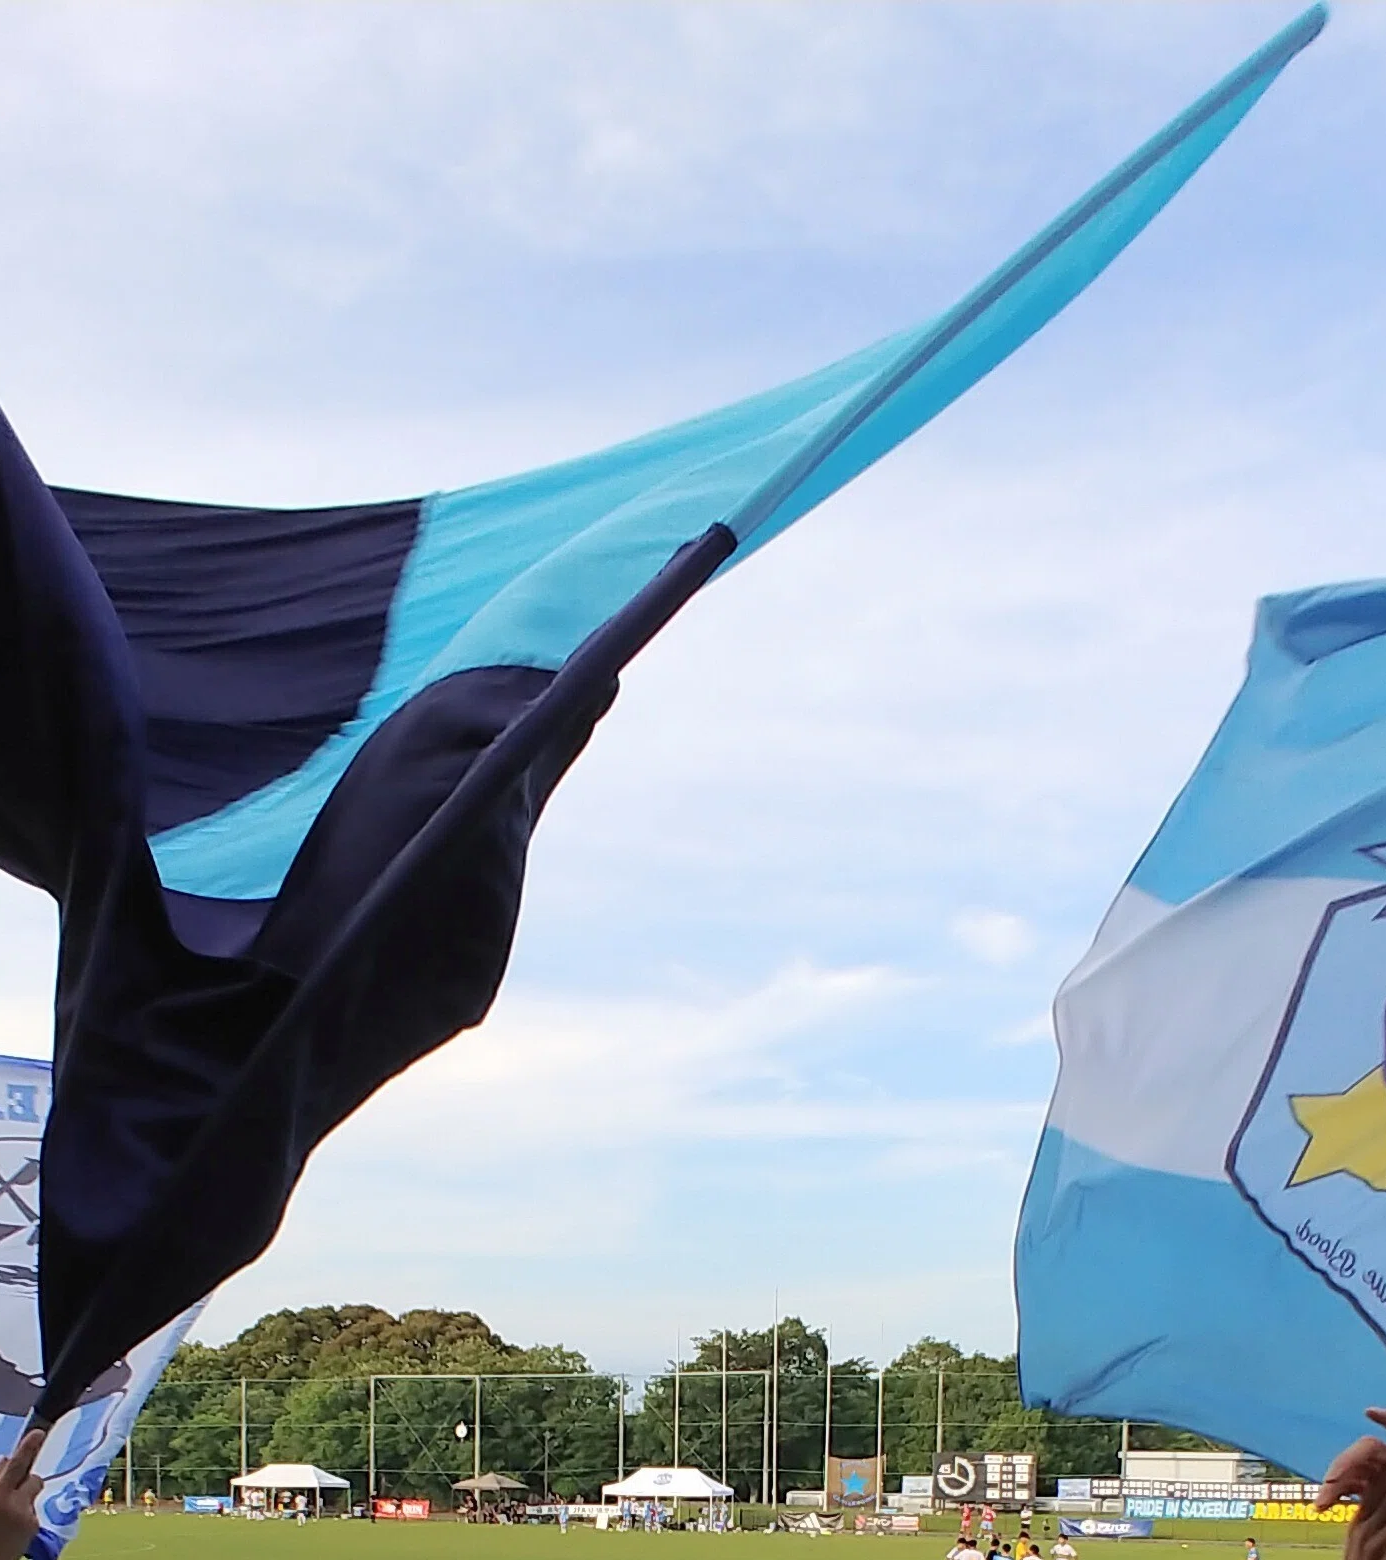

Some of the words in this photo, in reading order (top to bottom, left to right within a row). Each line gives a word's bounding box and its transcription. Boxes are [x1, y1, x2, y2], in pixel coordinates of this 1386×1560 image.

[1125, 1498, 1163, 1517] PRIDE
[1164, 1499, 1179, 1518] IN
[1181, 1499, 1250, 1519] SAXEBLUE
